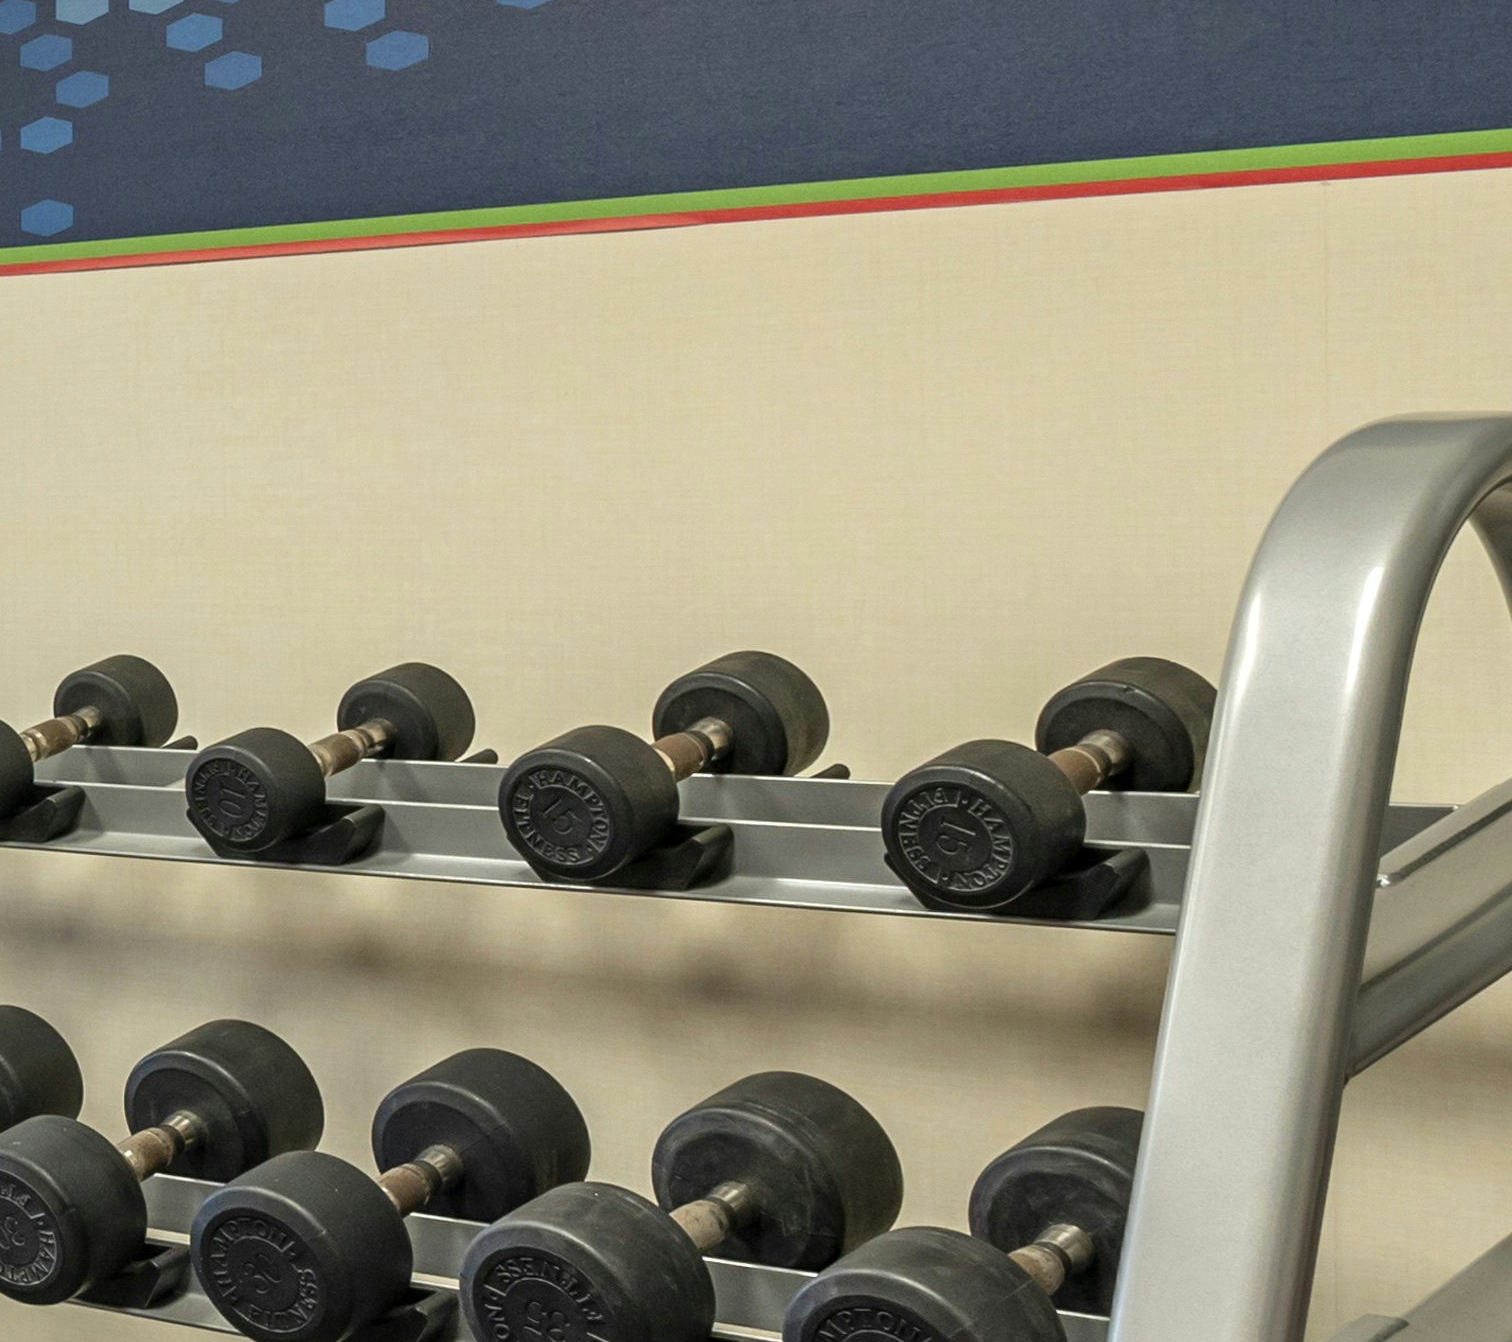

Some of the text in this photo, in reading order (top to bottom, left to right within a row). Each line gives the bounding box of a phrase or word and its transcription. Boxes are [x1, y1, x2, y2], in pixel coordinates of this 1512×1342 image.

[218, 784, 247, 820] 10
[513, 793, 581, 864] FITNESS
[532, 770, 611, 853] HAMPTON
[535, 794, 584, 836] 15
[898, 786, 946, 874] FITNESS
[934, 816, 977, 857] 15
[950, 798, 1014, 889] HAMPTON
[493, 1257, 604, 1323] FITNESS
